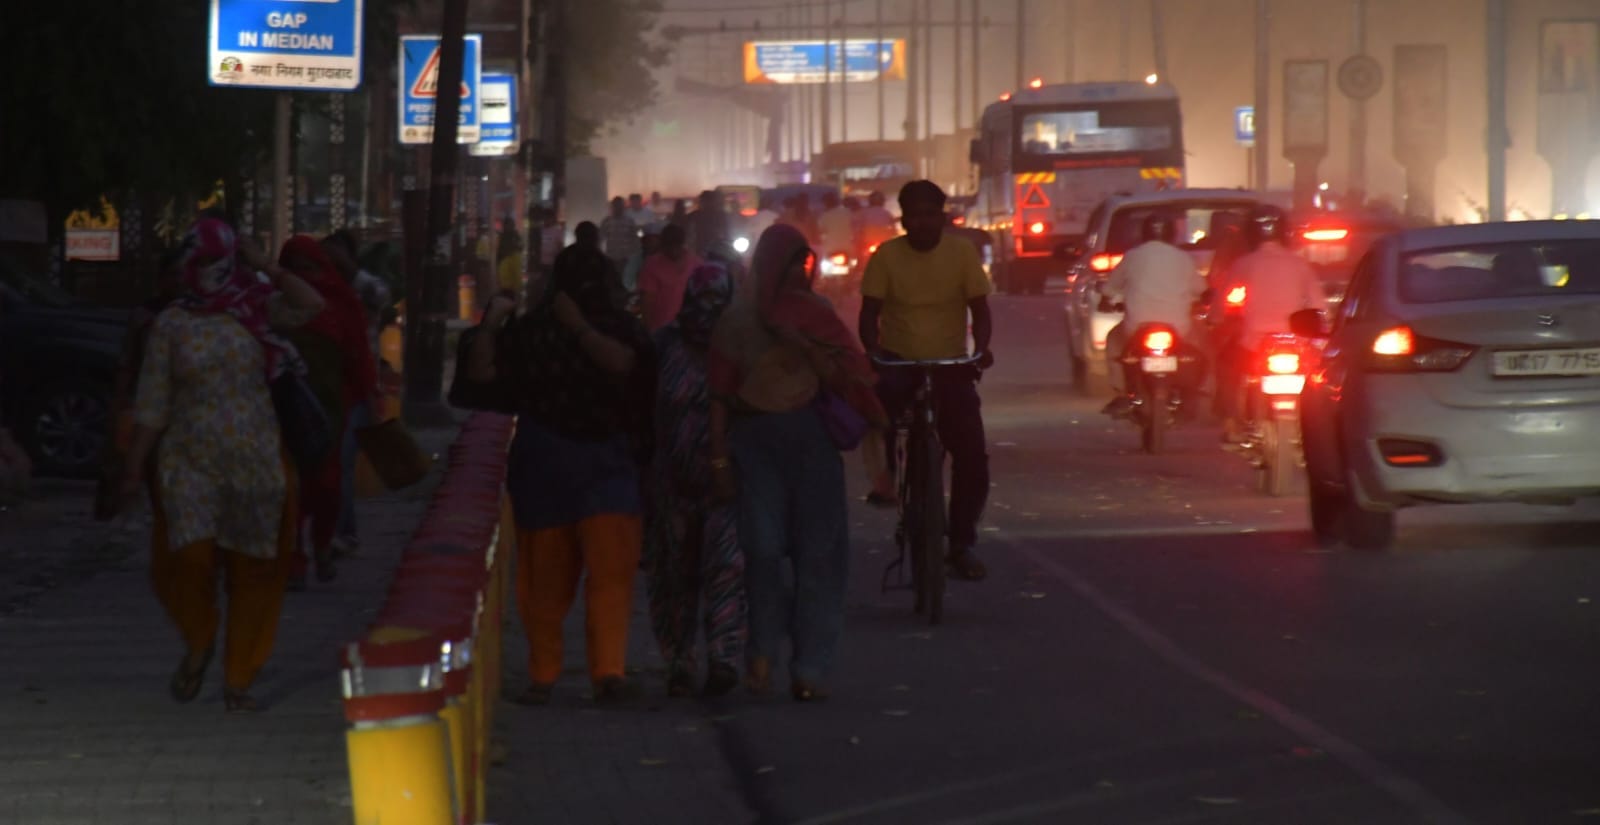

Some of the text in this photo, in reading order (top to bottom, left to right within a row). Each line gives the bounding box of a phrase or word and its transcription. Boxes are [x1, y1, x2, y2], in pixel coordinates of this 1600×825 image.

[266, 11, 307, 28] GAP
[237, 31, 334, 50] IN MEDIAN
